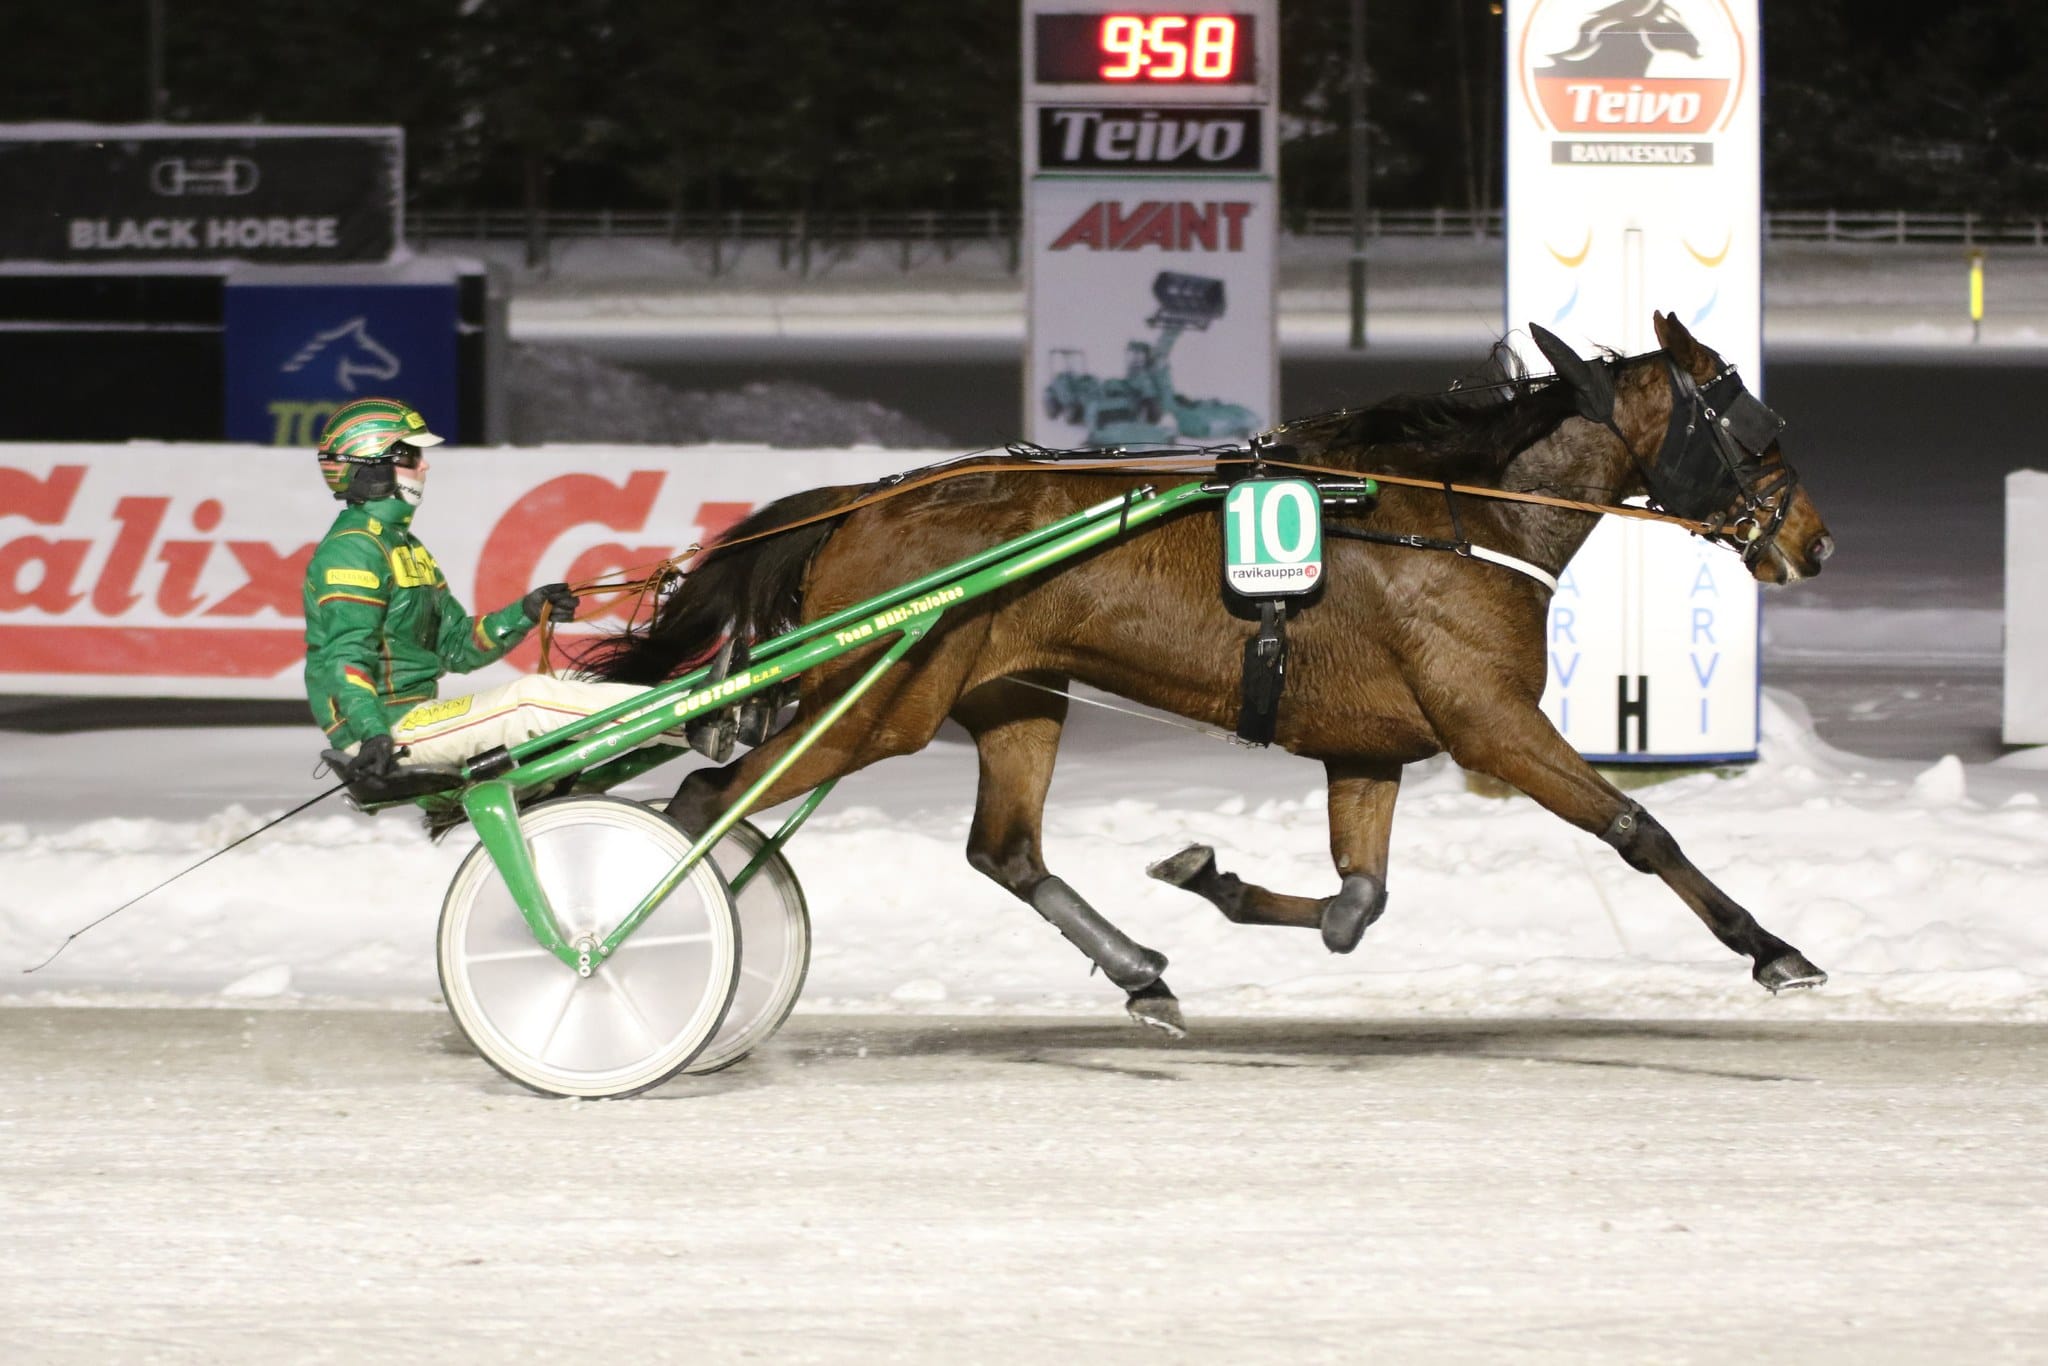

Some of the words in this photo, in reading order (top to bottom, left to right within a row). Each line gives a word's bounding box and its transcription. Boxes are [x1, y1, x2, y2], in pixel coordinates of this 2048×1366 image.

[1101, 16, 1236, 78] 9:58
[1566, 85, 1701, 124] Teivo
[1053, 111, 1245, 162] Teivo
[1570, 144, 1696, 163] RAVIKESKUS
[69, 219, 197, 250] BLACK
[207, 217, 339, 249] HORSE
[1048, 202, 1252, 251] AVANT
[1229, 483, 1317, 564] 10
[674, 672, 751, 717] CUSTOM
